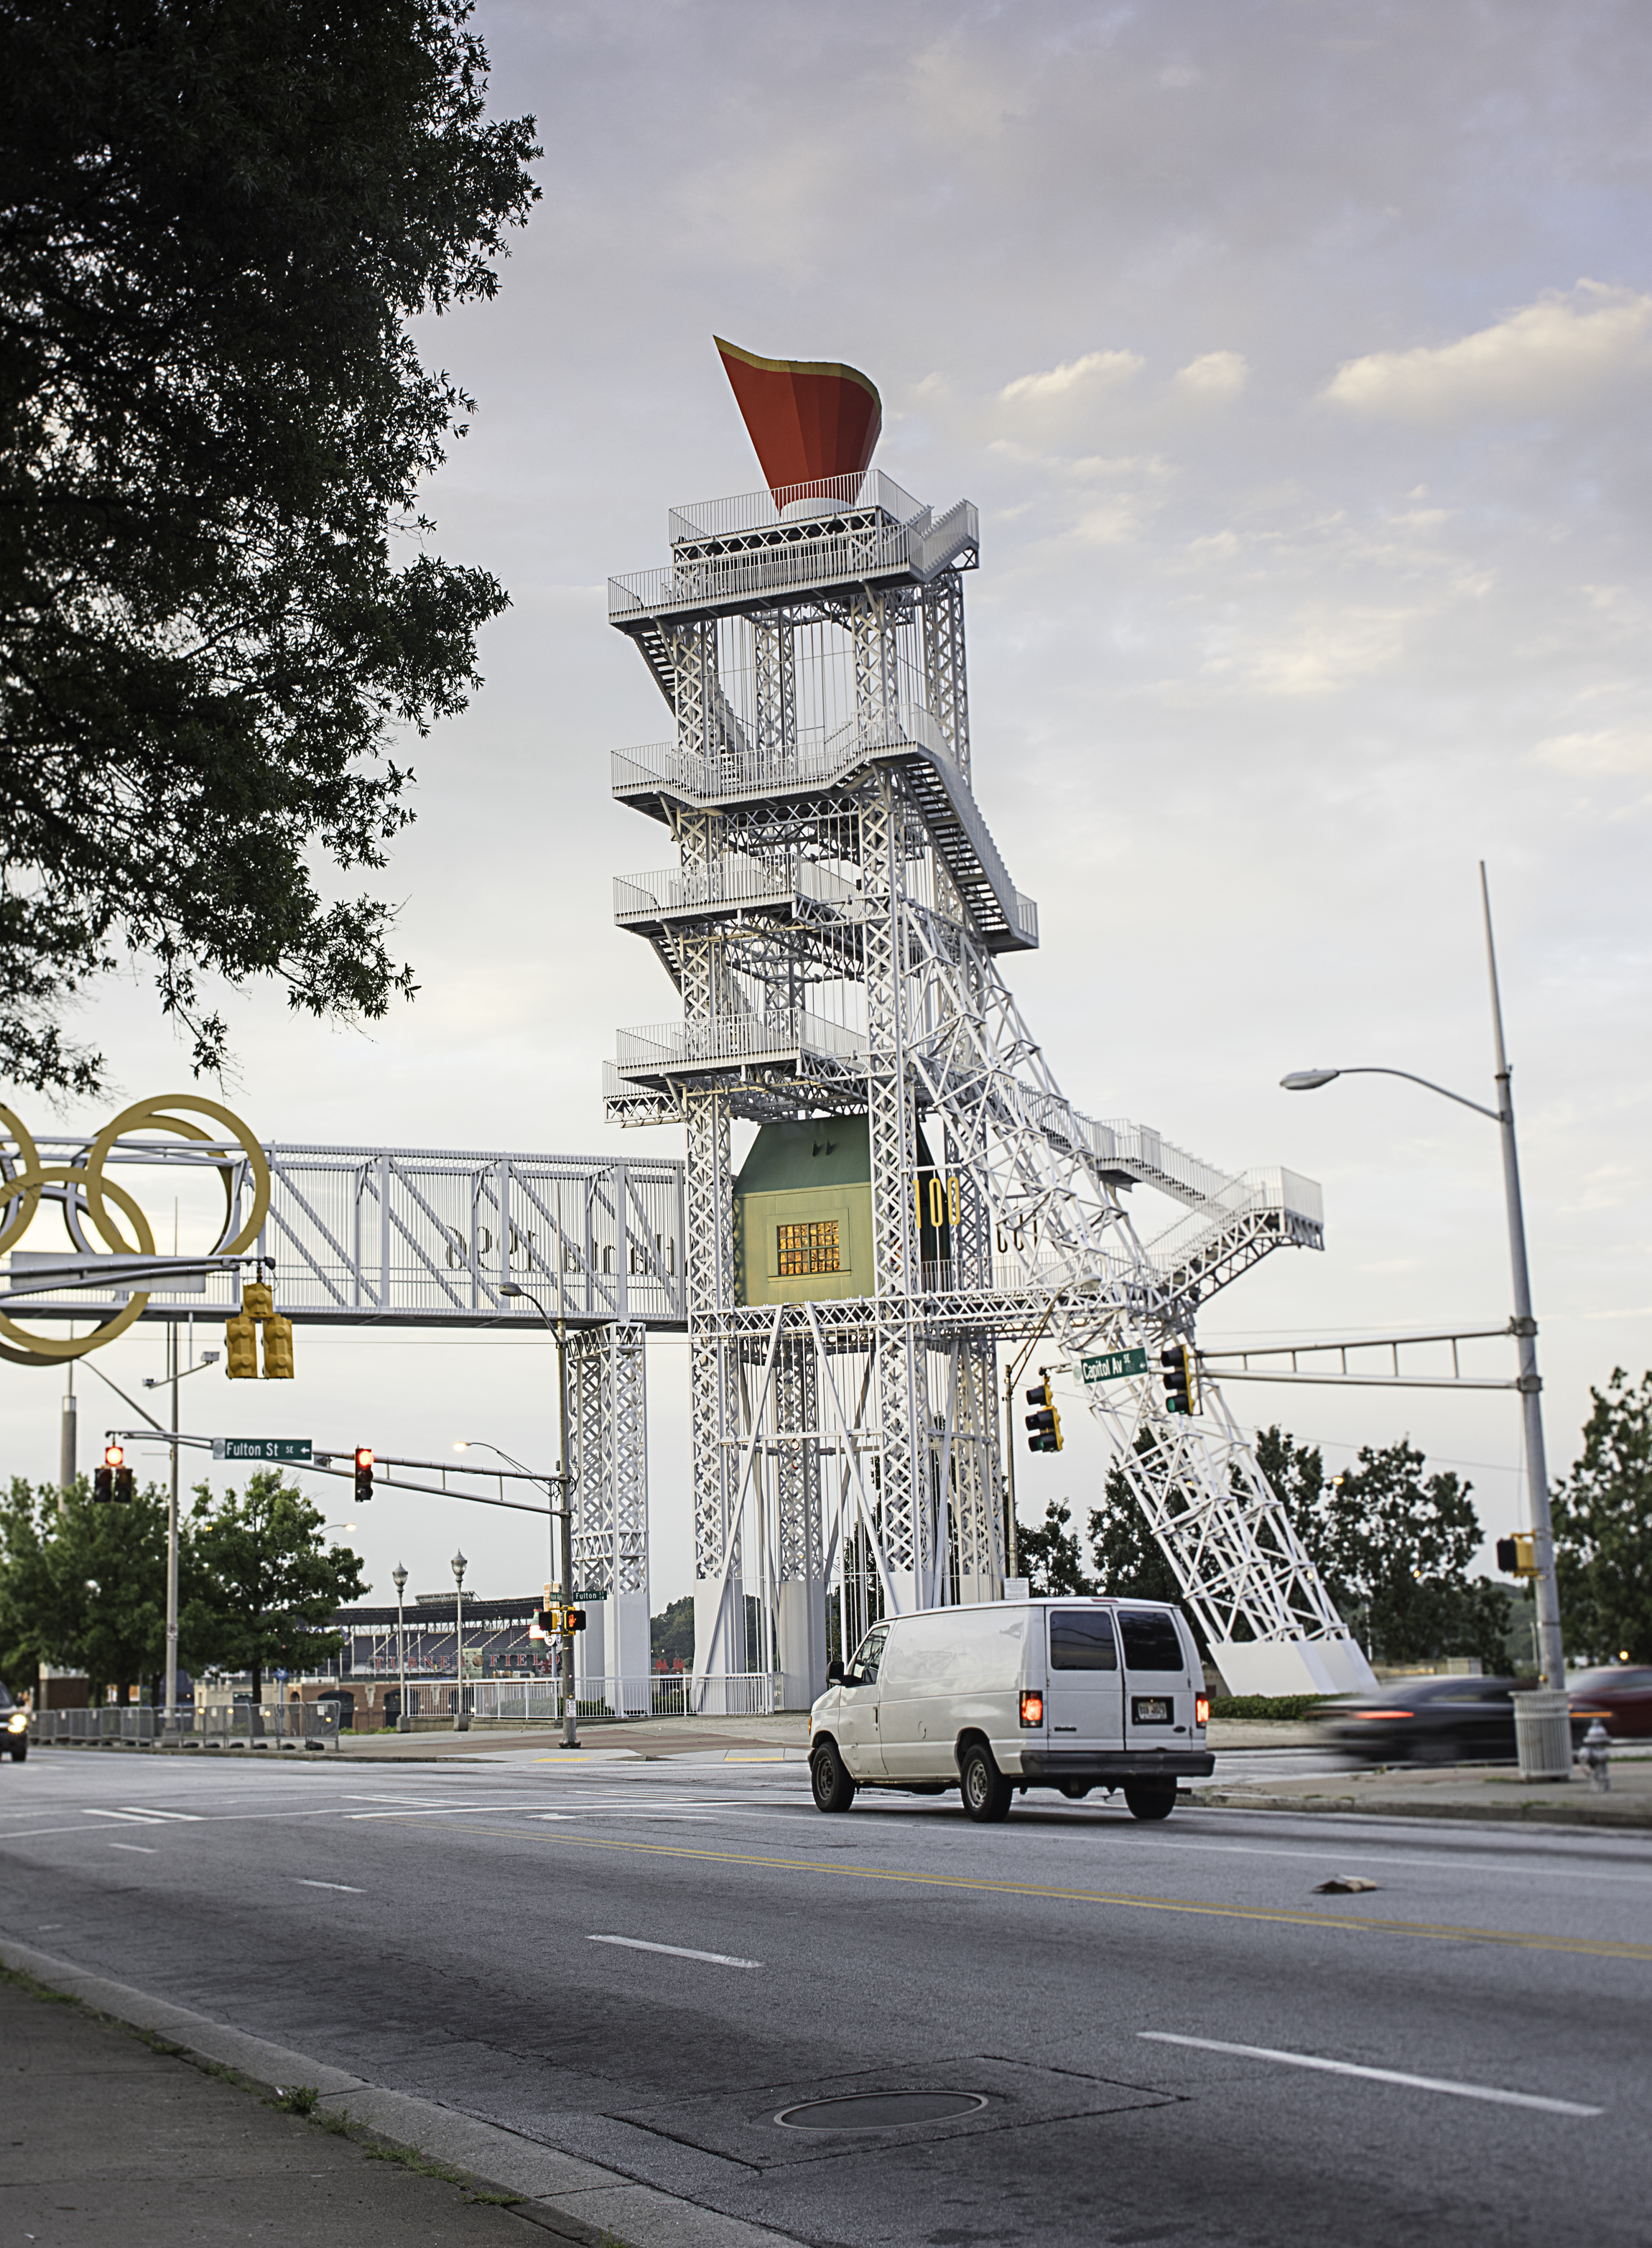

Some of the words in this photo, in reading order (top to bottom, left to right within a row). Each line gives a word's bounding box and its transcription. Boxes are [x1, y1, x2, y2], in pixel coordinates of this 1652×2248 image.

[911, 1176, 961, 1229] 100
[1082, 1358, 1111, 1382] Capitol
[1112, 1357, 1123, 1375] Av
[1123, 1353, 1131, 1364] SE
[226, 1441, 261, 1457] Fulton
[266, 1442, 279, 1457] St
[373, 1655, 467, 1671] TURNER
[490, 1653, 560, 1667] FIELD
